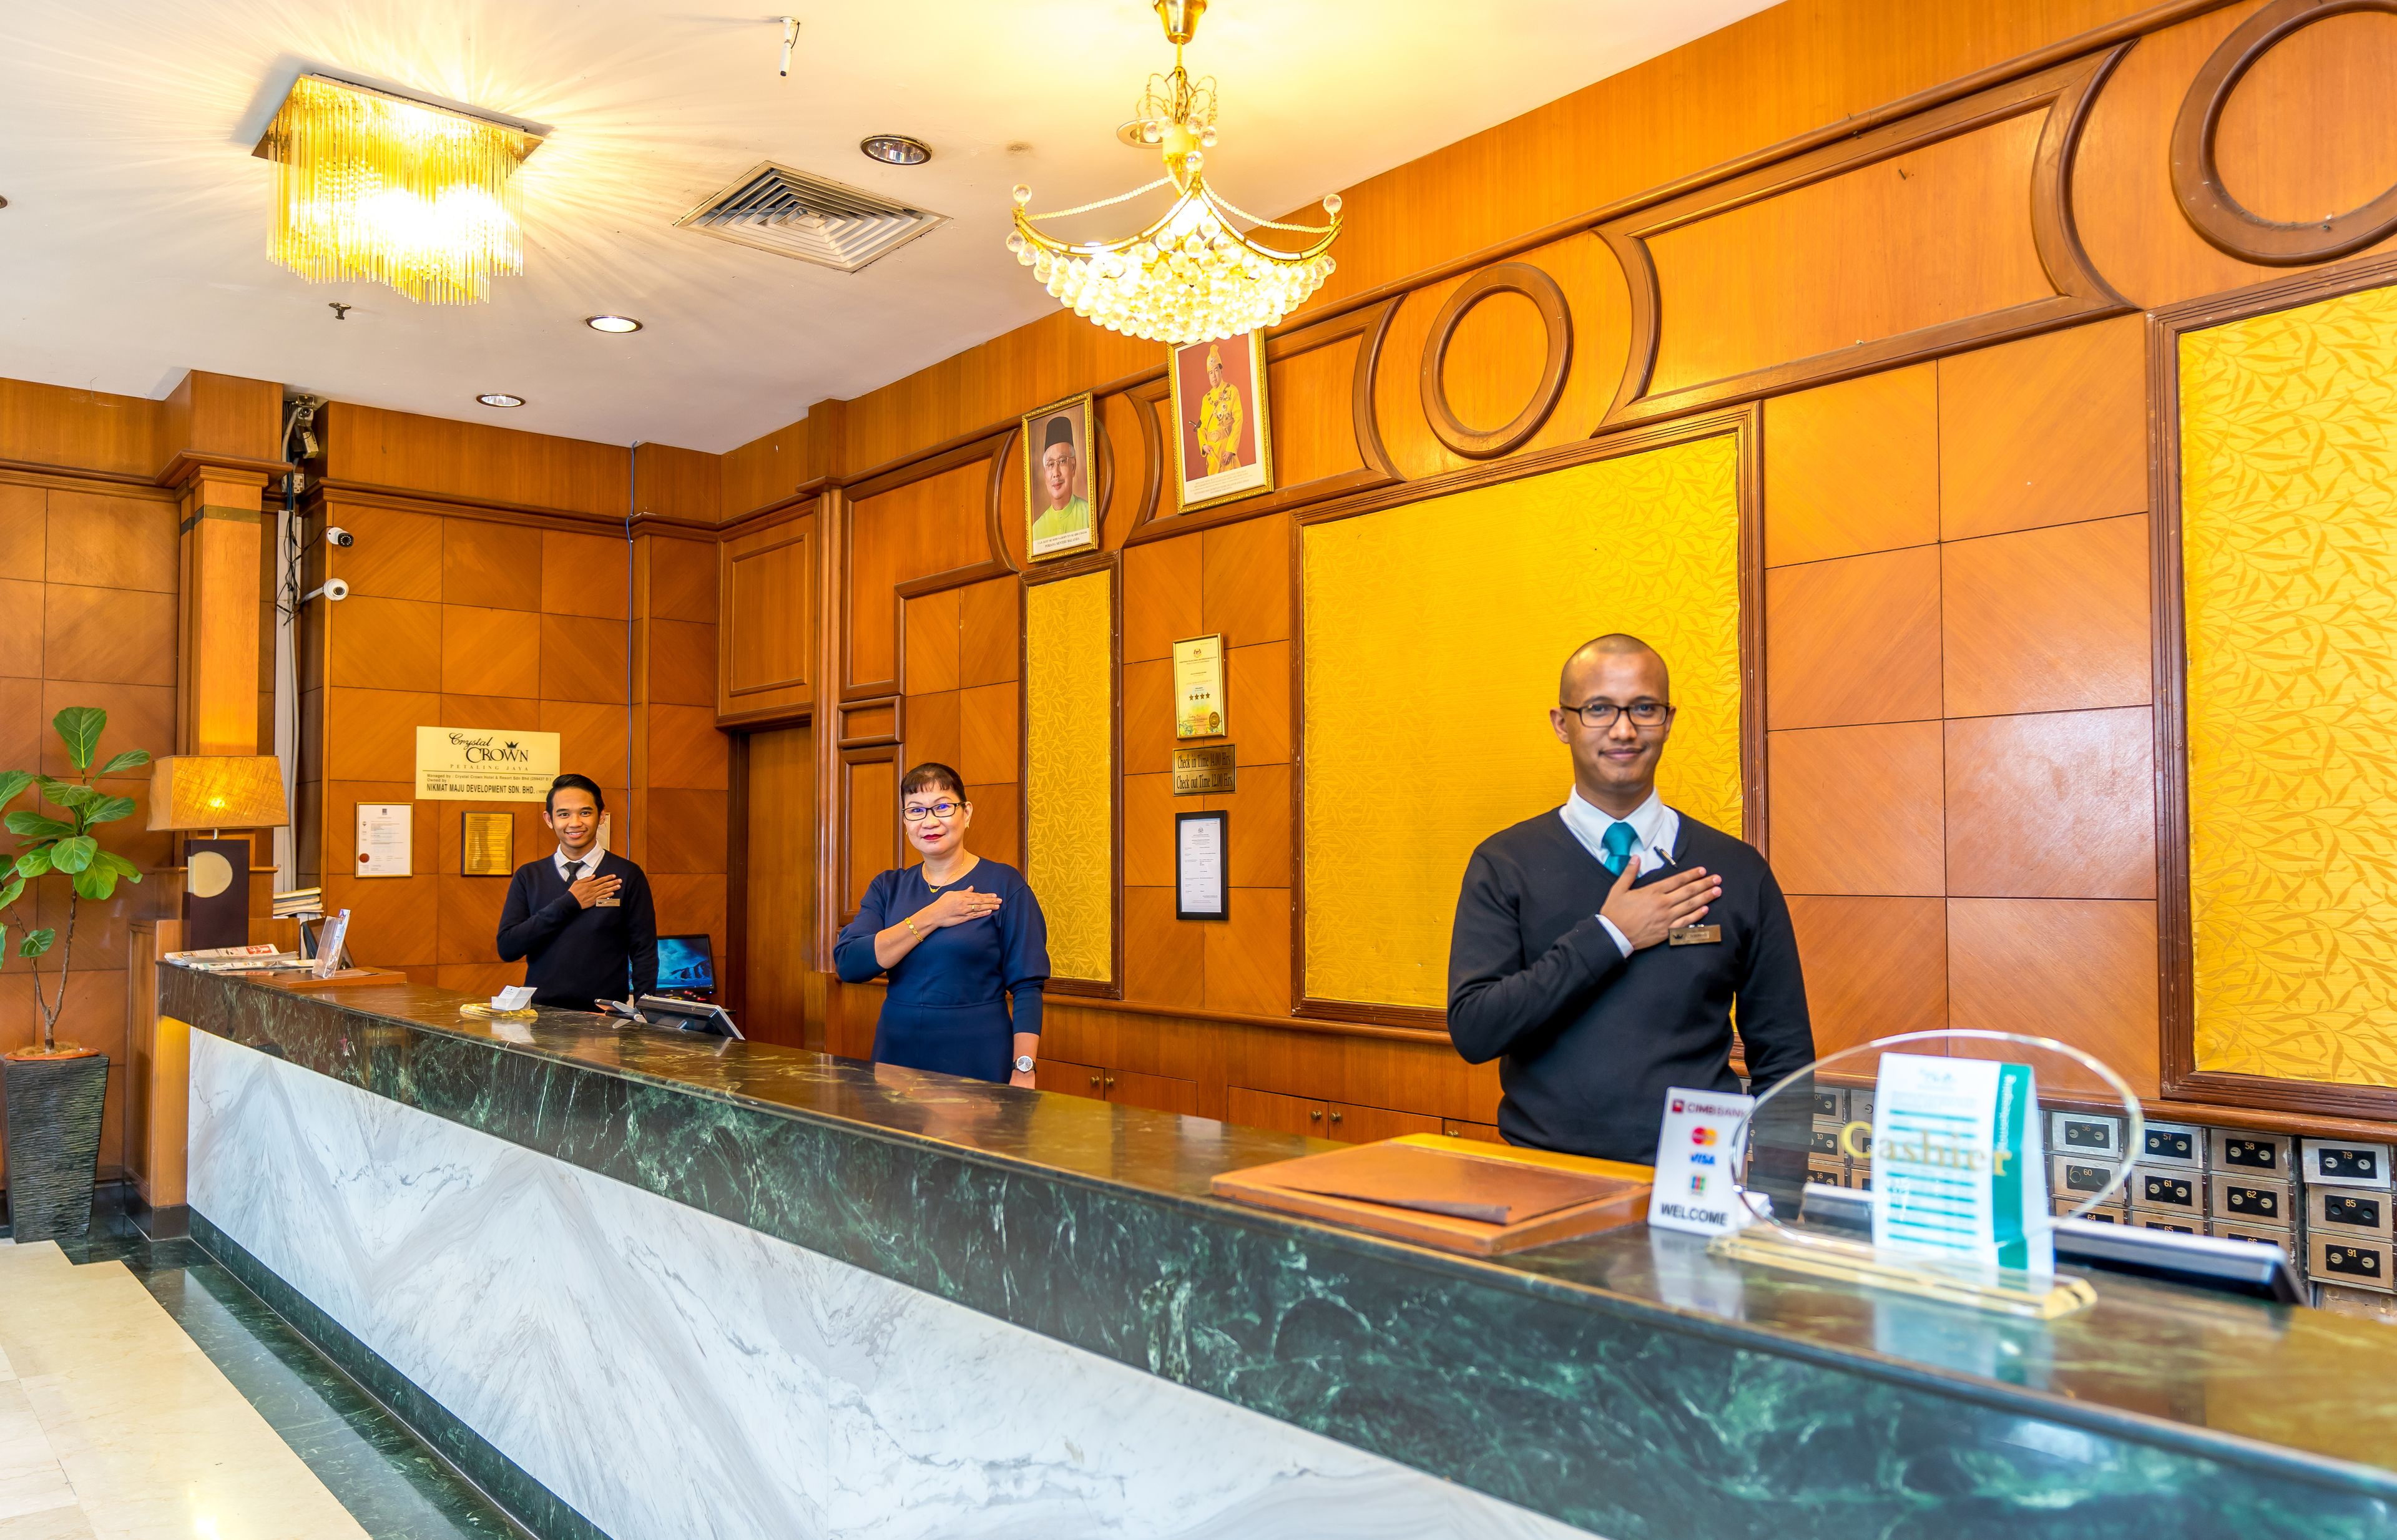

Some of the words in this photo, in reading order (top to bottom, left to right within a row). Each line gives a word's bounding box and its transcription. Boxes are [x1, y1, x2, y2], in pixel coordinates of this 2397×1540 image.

[449, 732, 493, 750] Crystal
[466, 747, 529, 763] CROWN
[1177, 753, 1190, 768] Check
[1192, 753, 1197, 767] in
[1197, 753, 1209, 767] Time
[1222, 752, 1231, 765] Hrs
[1176, 774, 1190, 789] Check
[1198, 774, 1210, 788] Time
[1223, 773, 1233, 787] Hrs
[426, 783, 448, 792] NIKMAT
[449, 784, 464, 792] MAJU
[466, 784, 507, 793] DEVELOPMENT
[508, 785, 521, 793] SDN.
[522, 786, 535, 794] BHD.
[1841, 1120, 2013, 1177] Cashier
[1690, 1154, 1715, 1165] VISA
[2342, 1151, 2353, 1159] 79
[2247, 1190, 2257, 1199] 62
[2345, 1199, 2356, 1207] 85
[1661, 1202, 1728, 1227] WELCOME
[2164, 1225, 2174, 1233] 65
[2347, 1249, 2357, 1257] 91
